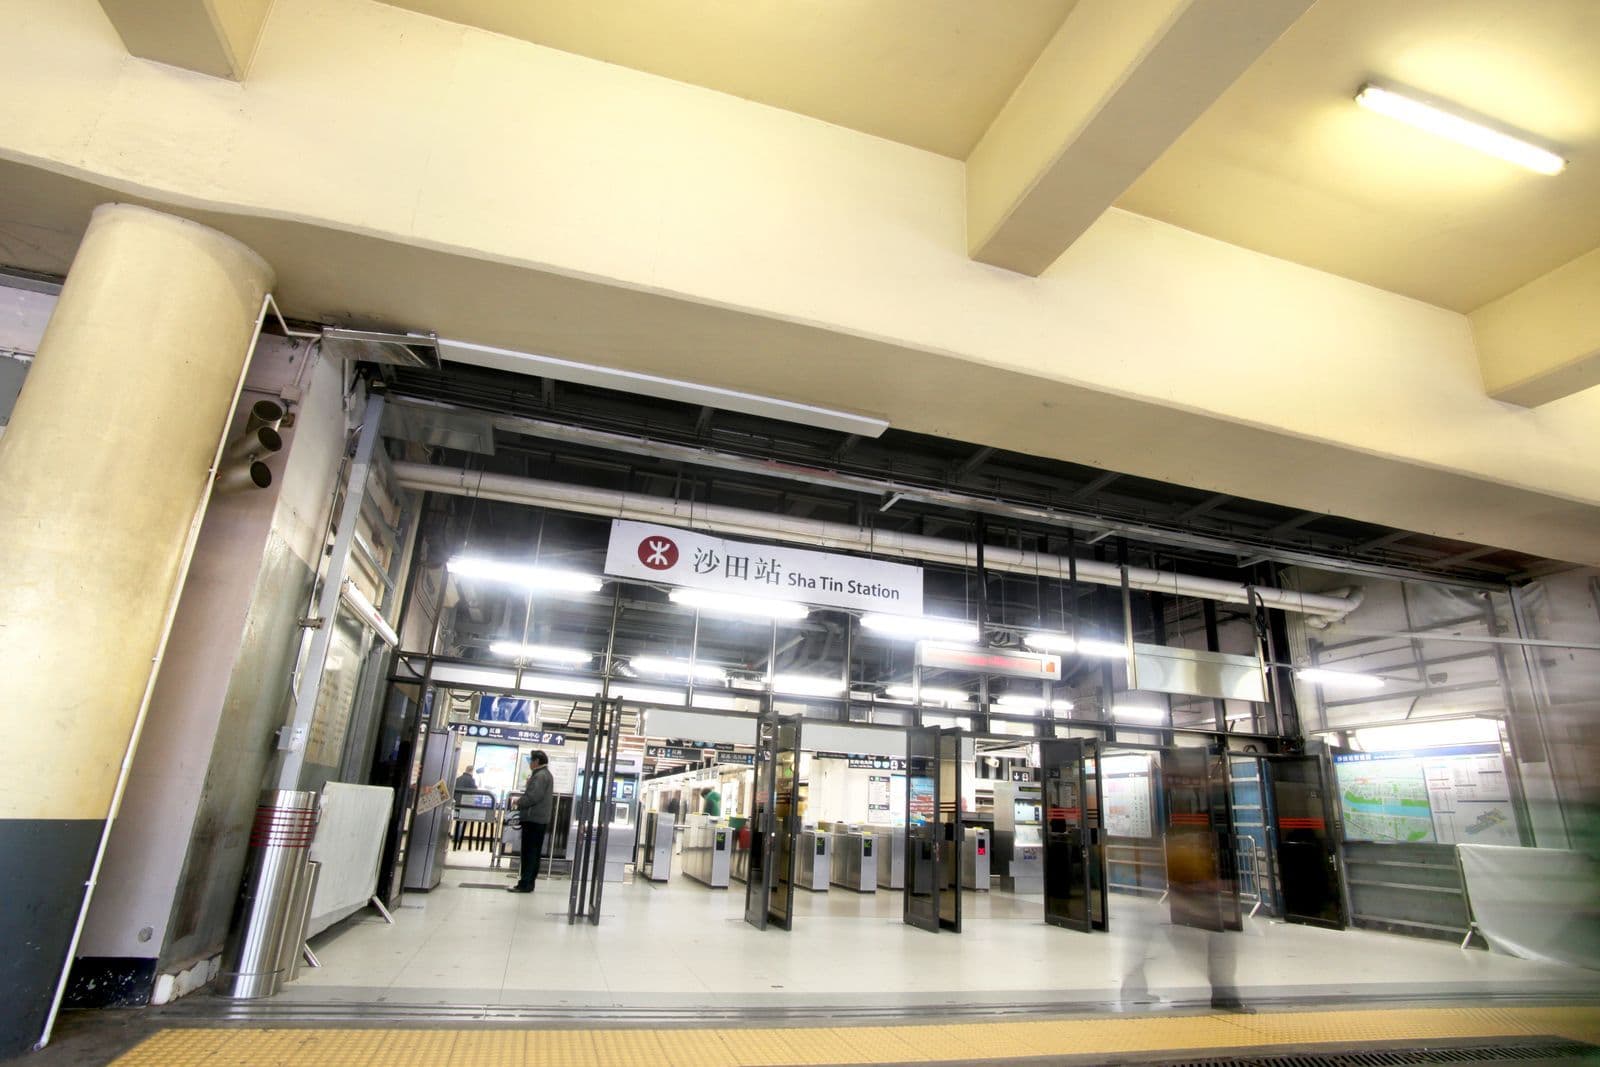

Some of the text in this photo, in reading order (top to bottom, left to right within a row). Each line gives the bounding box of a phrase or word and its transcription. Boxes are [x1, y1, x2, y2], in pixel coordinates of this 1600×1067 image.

[693, 547, 782, 585] 沙田站
[788, 572, 900, 600] Sha Tin Station
